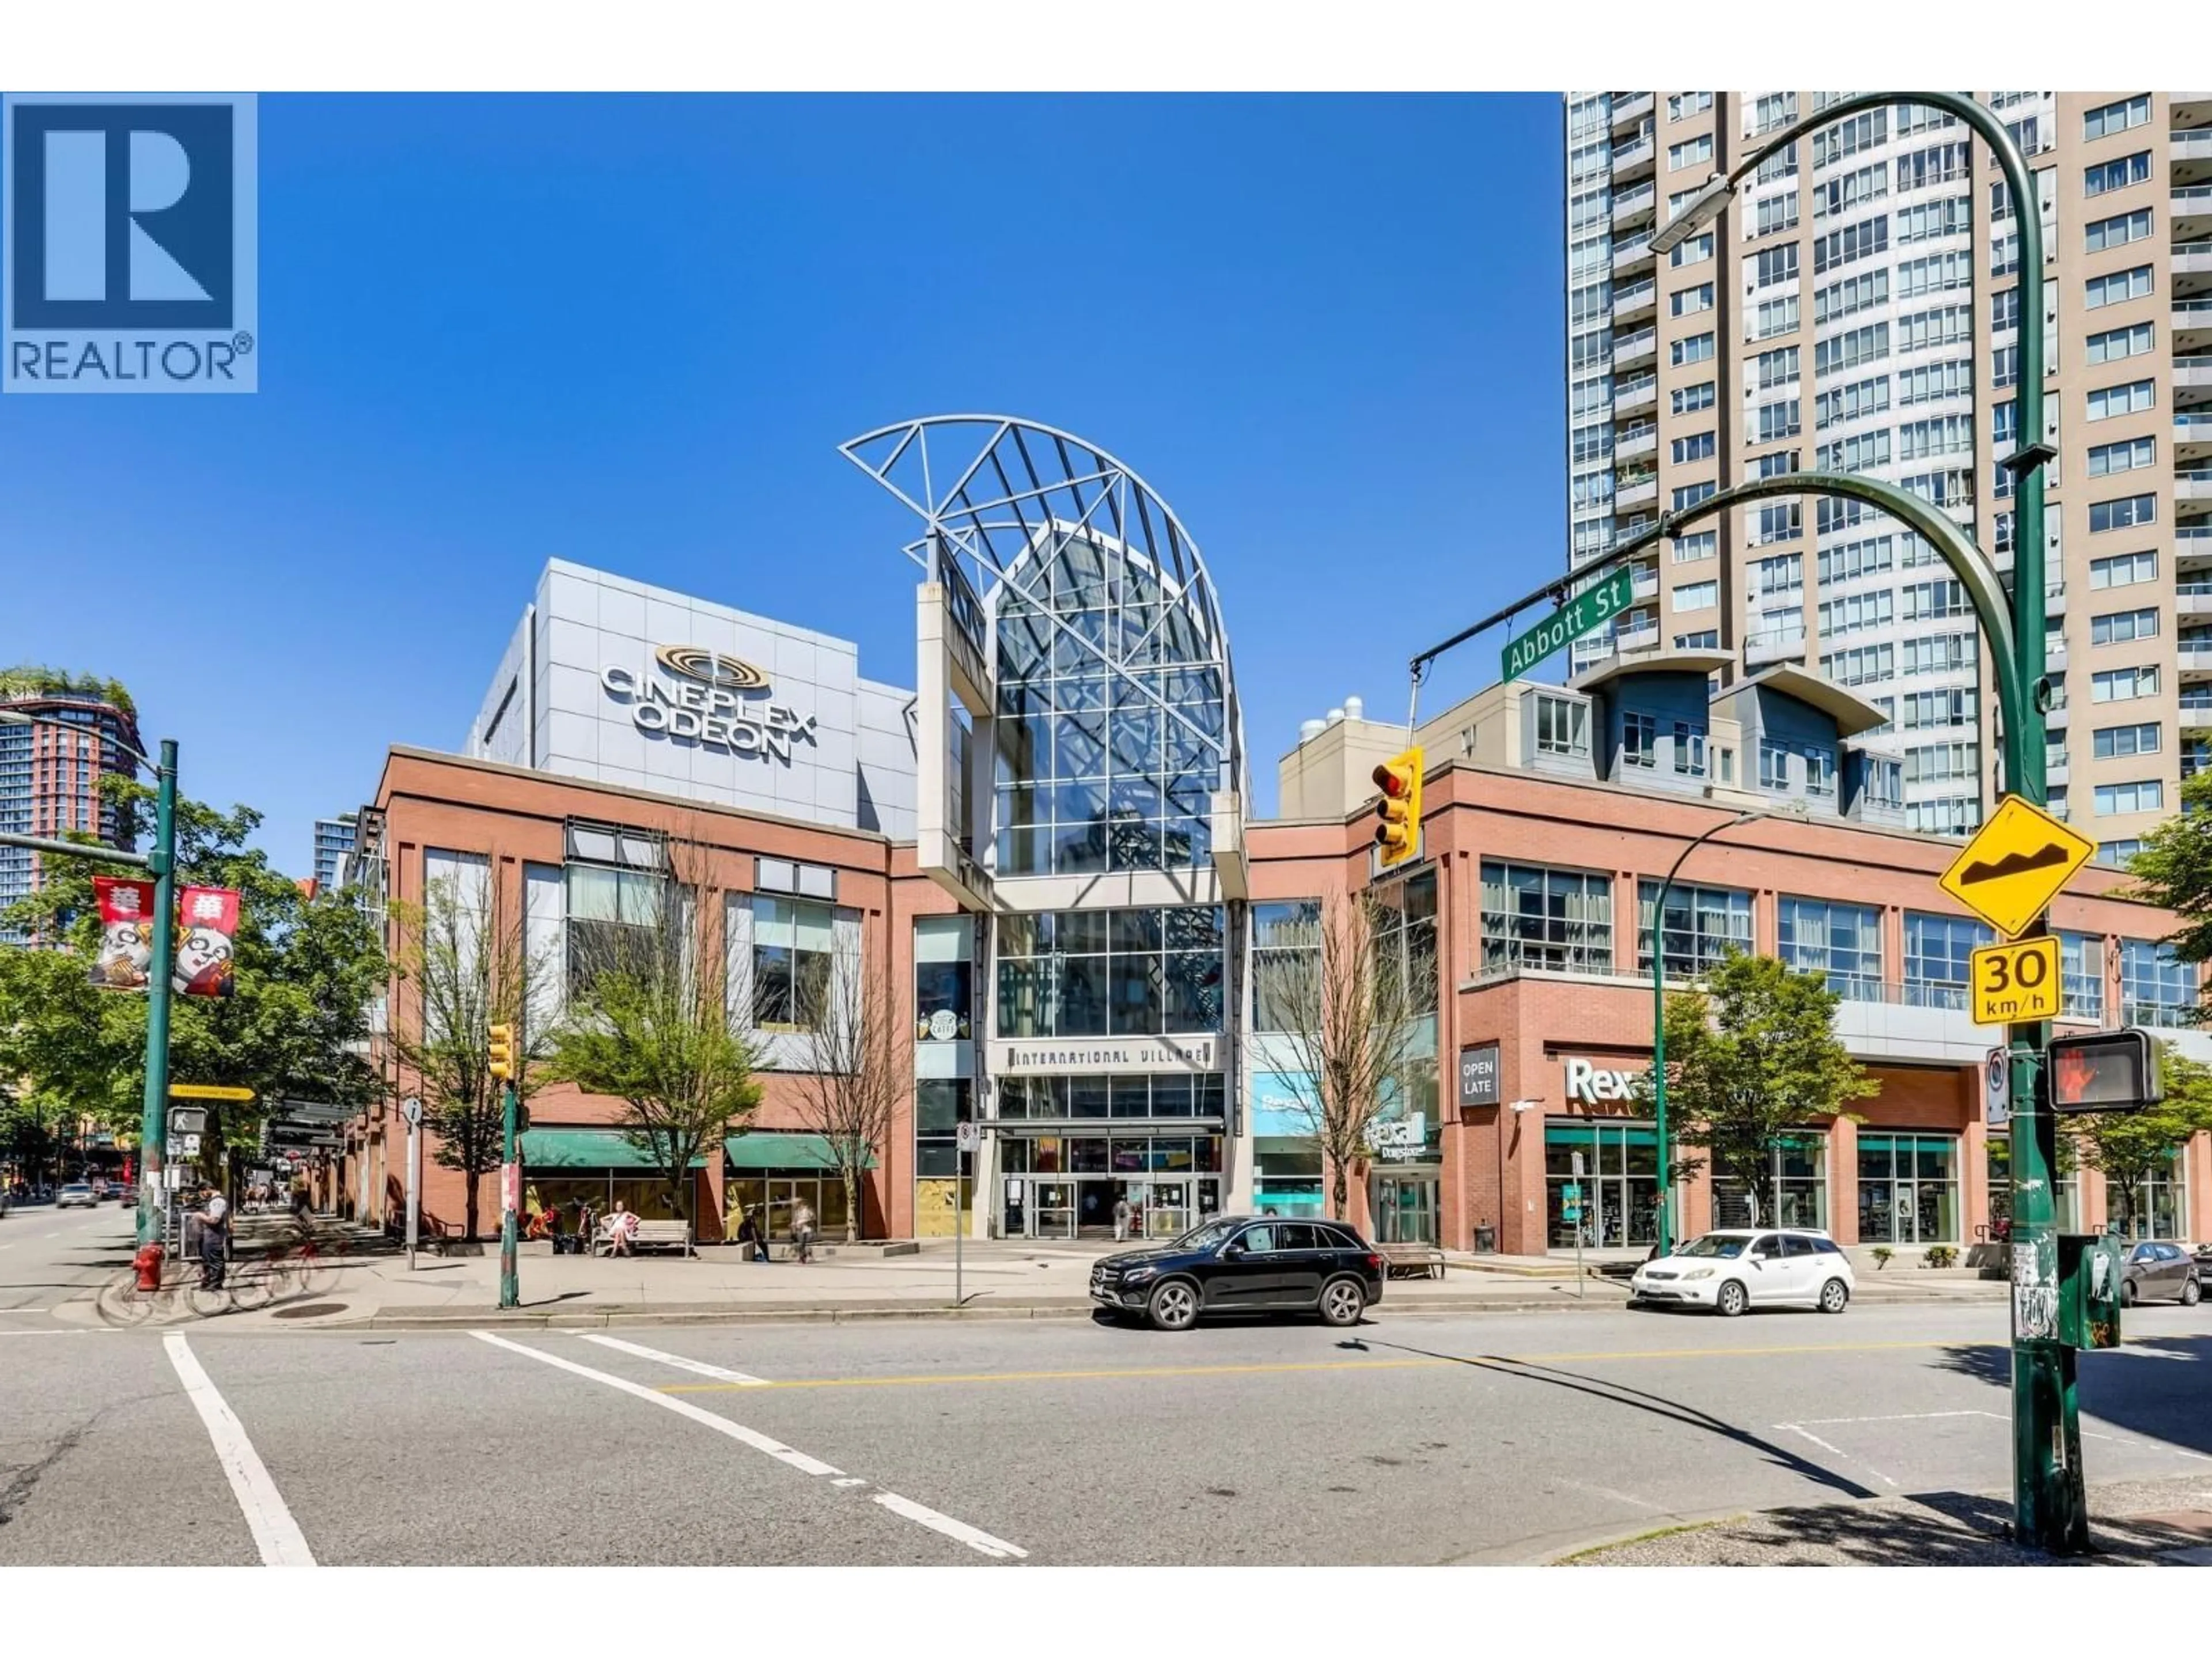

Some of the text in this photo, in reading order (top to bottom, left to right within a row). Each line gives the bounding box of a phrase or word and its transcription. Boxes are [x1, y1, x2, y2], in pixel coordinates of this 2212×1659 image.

[1510, 580, 1621, 674] Abbott St
[601, 664, 816, 737] CINEPLEX
[632, 702, 790, 757] ODEON
[1984, 949, 2047, 993] 30
[1987, 993, 2044, 1016] km/h
[1016, 1047, 1202, 1066] INTERNATIONAL VILLAGE
[1463, 1060, 1493, 1077] OPEN
[1465, 1080, 1492, 1094] LATE
